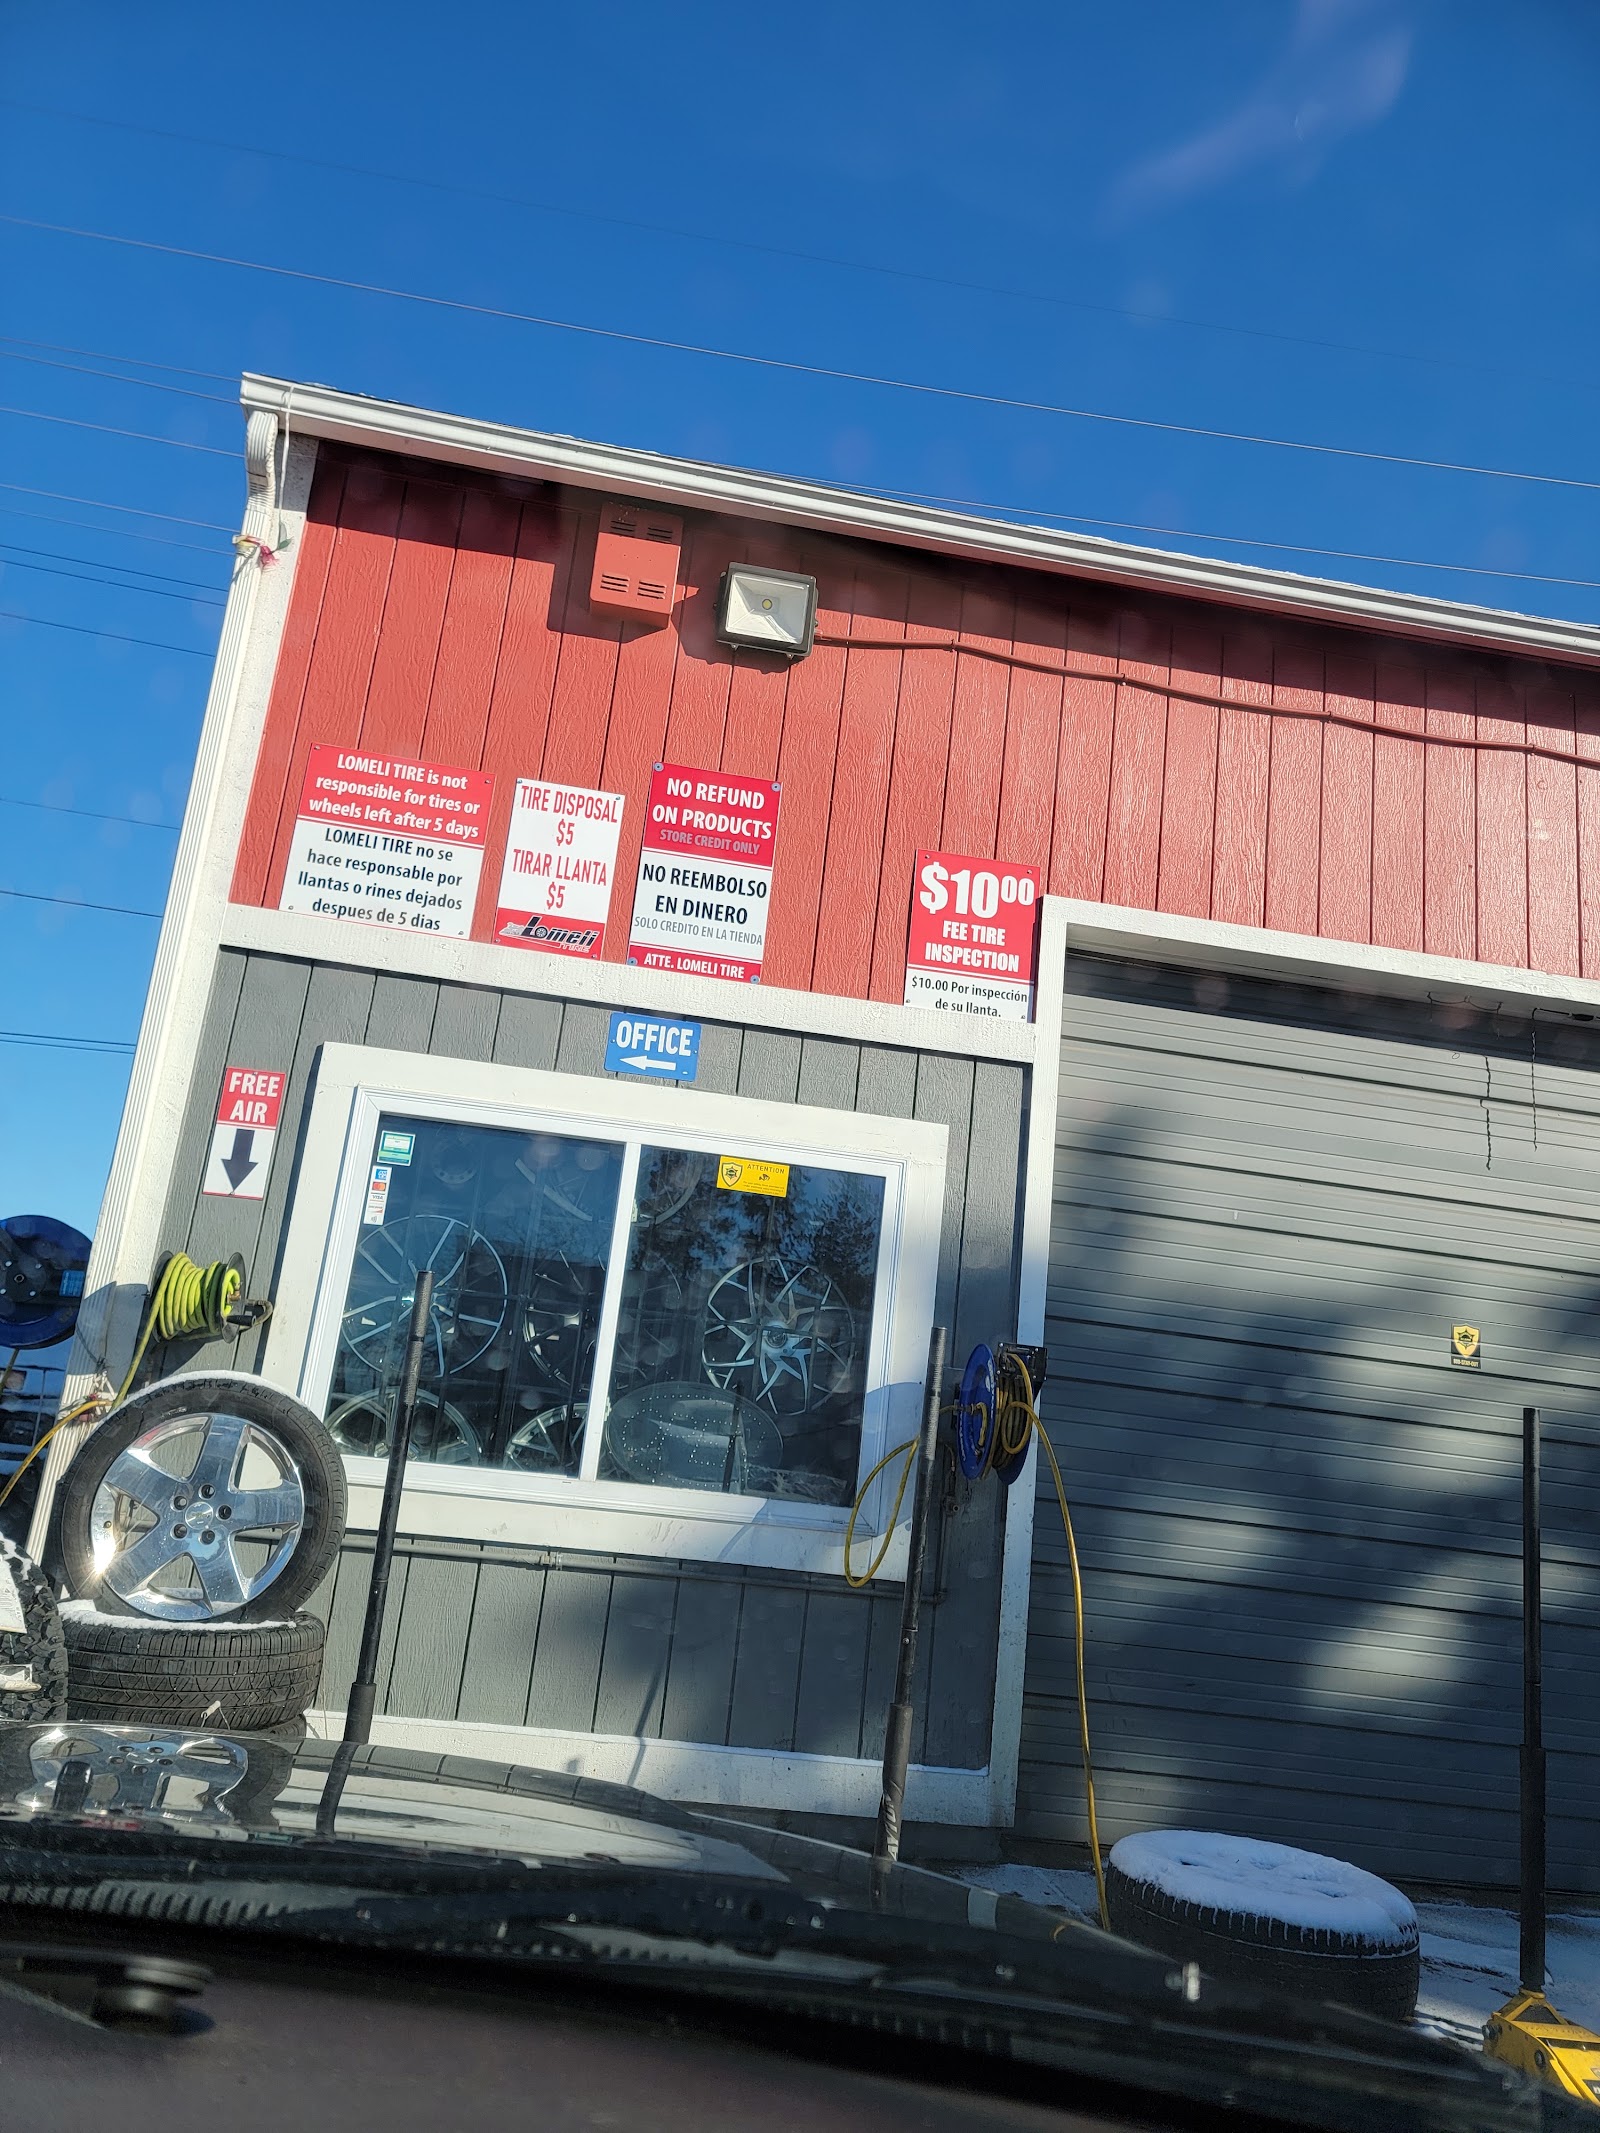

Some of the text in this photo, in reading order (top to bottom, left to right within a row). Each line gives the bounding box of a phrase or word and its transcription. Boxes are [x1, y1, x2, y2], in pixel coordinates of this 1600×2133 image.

[337, 754, 468, 789] LOMELI TIRE is not
[316, 776, 480, 814] responsible for tires or
[521, 785, 618, 823] TIRE DISPOSAL
[667, 778, 765, 809] NO REFUND
[309, 798, 479, 840] wheels left after 5 days
[556, 819, 575, 846] $5
[652, 805, 772, 839] ON PRODUCTS
[325, 828, 453, 861] LOMELI TIRE no se
[660, 829, 760, 855] STORE CREDIT ONLY
[307, 849, 463, 886] hace responsable por
[512, 849, 607, 886] TIRAR LLANTA
[643, 863, 767, 898] NO REEMBOLSO
[298, 871, 462, 910] llantas o rines dejados
[547, 882, 566, 909] $5
[312, 899, 440, 931] despues de 5 dias
[655, 895, 748, 924] EN DINERO
[634, 917, 763, 945] SOLO CREDITO EN LA TIENDA
[943, 920, 1006, 946] FEE TIRE
[644, 953, 745, 978] ATTE. LOMELI TIRE
[925, 942, 1019, 972] INSPECTION
[912, 976, 1028, 1002] $10.00 Por inspección
[935, 998, 1001, 1018] de su llanta.
[616, 1021, 693, 1056] OFFICE
[229, 1072, 280, 1097] FREE
[230, 1100, 268, 1123] AIR
[746, 1164, 785, 1174] ATTENTION
